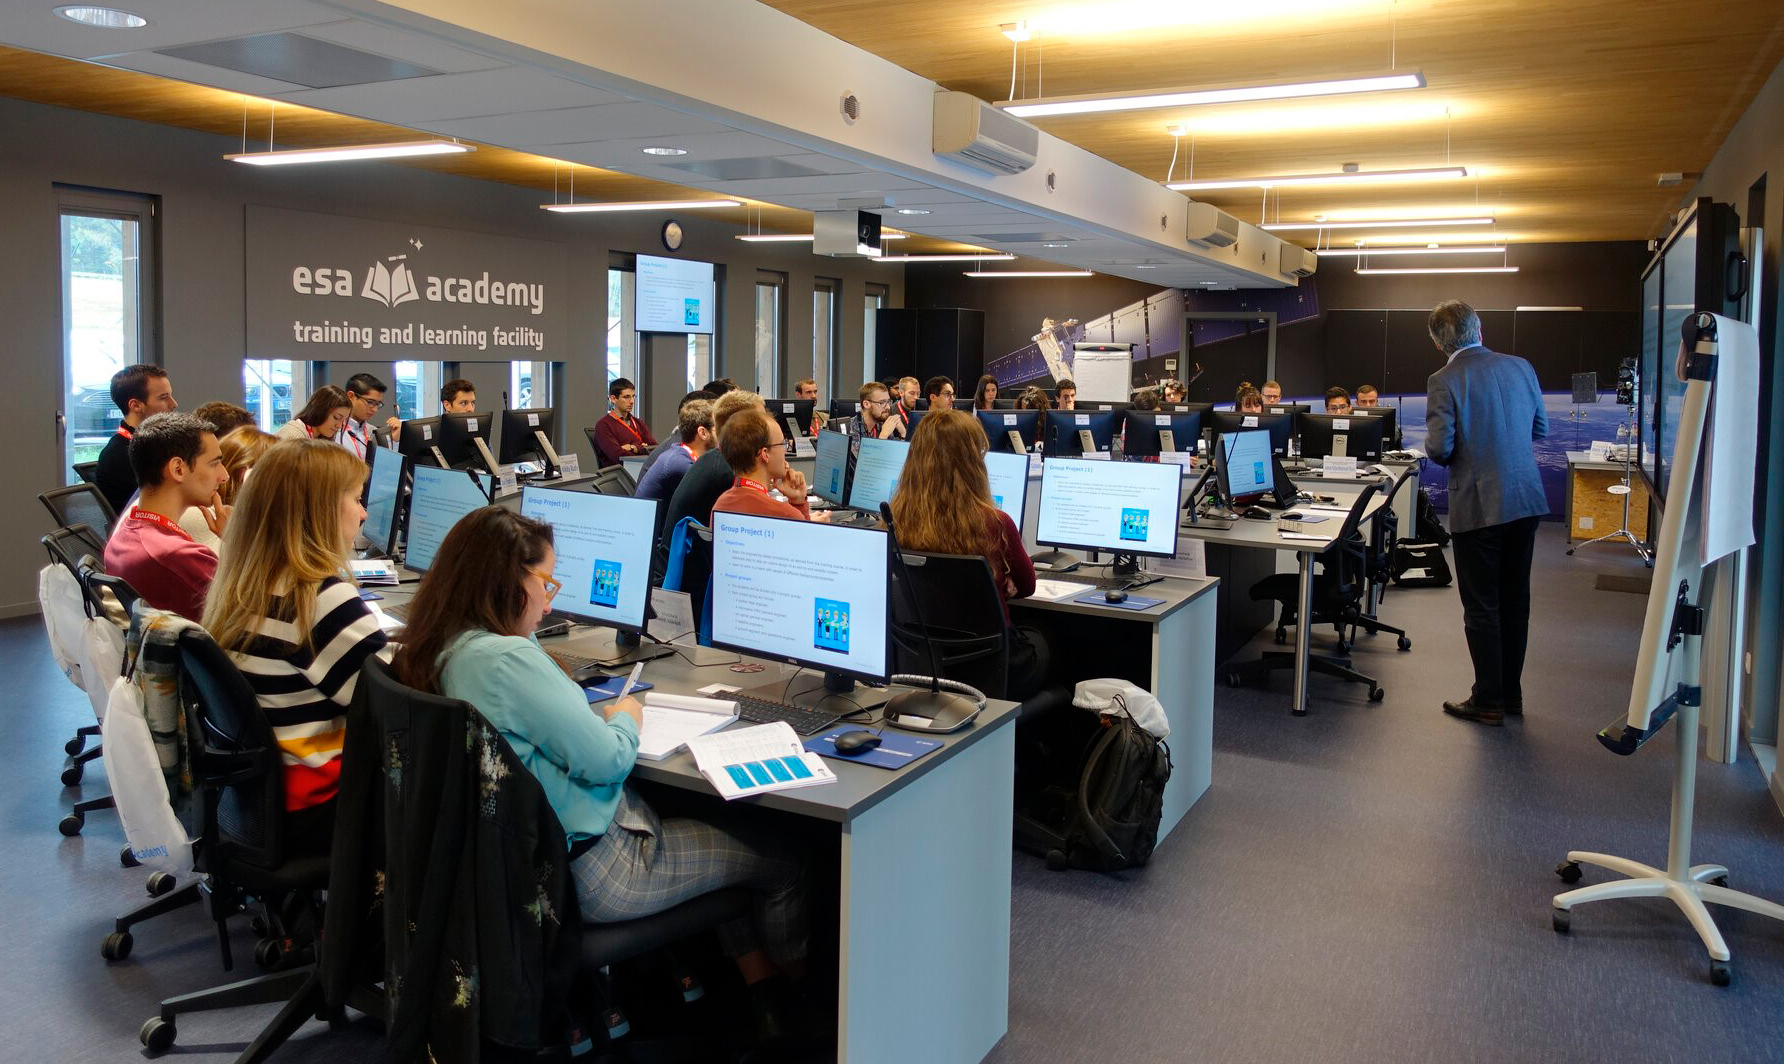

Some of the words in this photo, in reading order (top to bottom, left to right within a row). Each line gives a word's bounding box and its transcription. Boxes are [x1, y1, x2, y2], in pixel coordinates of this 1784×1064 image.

[292, 266, 353, 297] esa
[426, 271, 544, 315] academy
[293, 320, 373, 349] training
[379, 323, 413, 345] and
[419, 323, 487, 350] learning
[492, 326, 544, 351] facility
[528, 496, 543, 505] Group
[543, 499, 561, 508] Project
[561, 501, 571, 510] (1)
[135, 511, 161, 522] VISITOR
[720, 524, 739, 534] Group
[740, 526, 763, 537] Project
[764, 529, 775, 539] (1)
